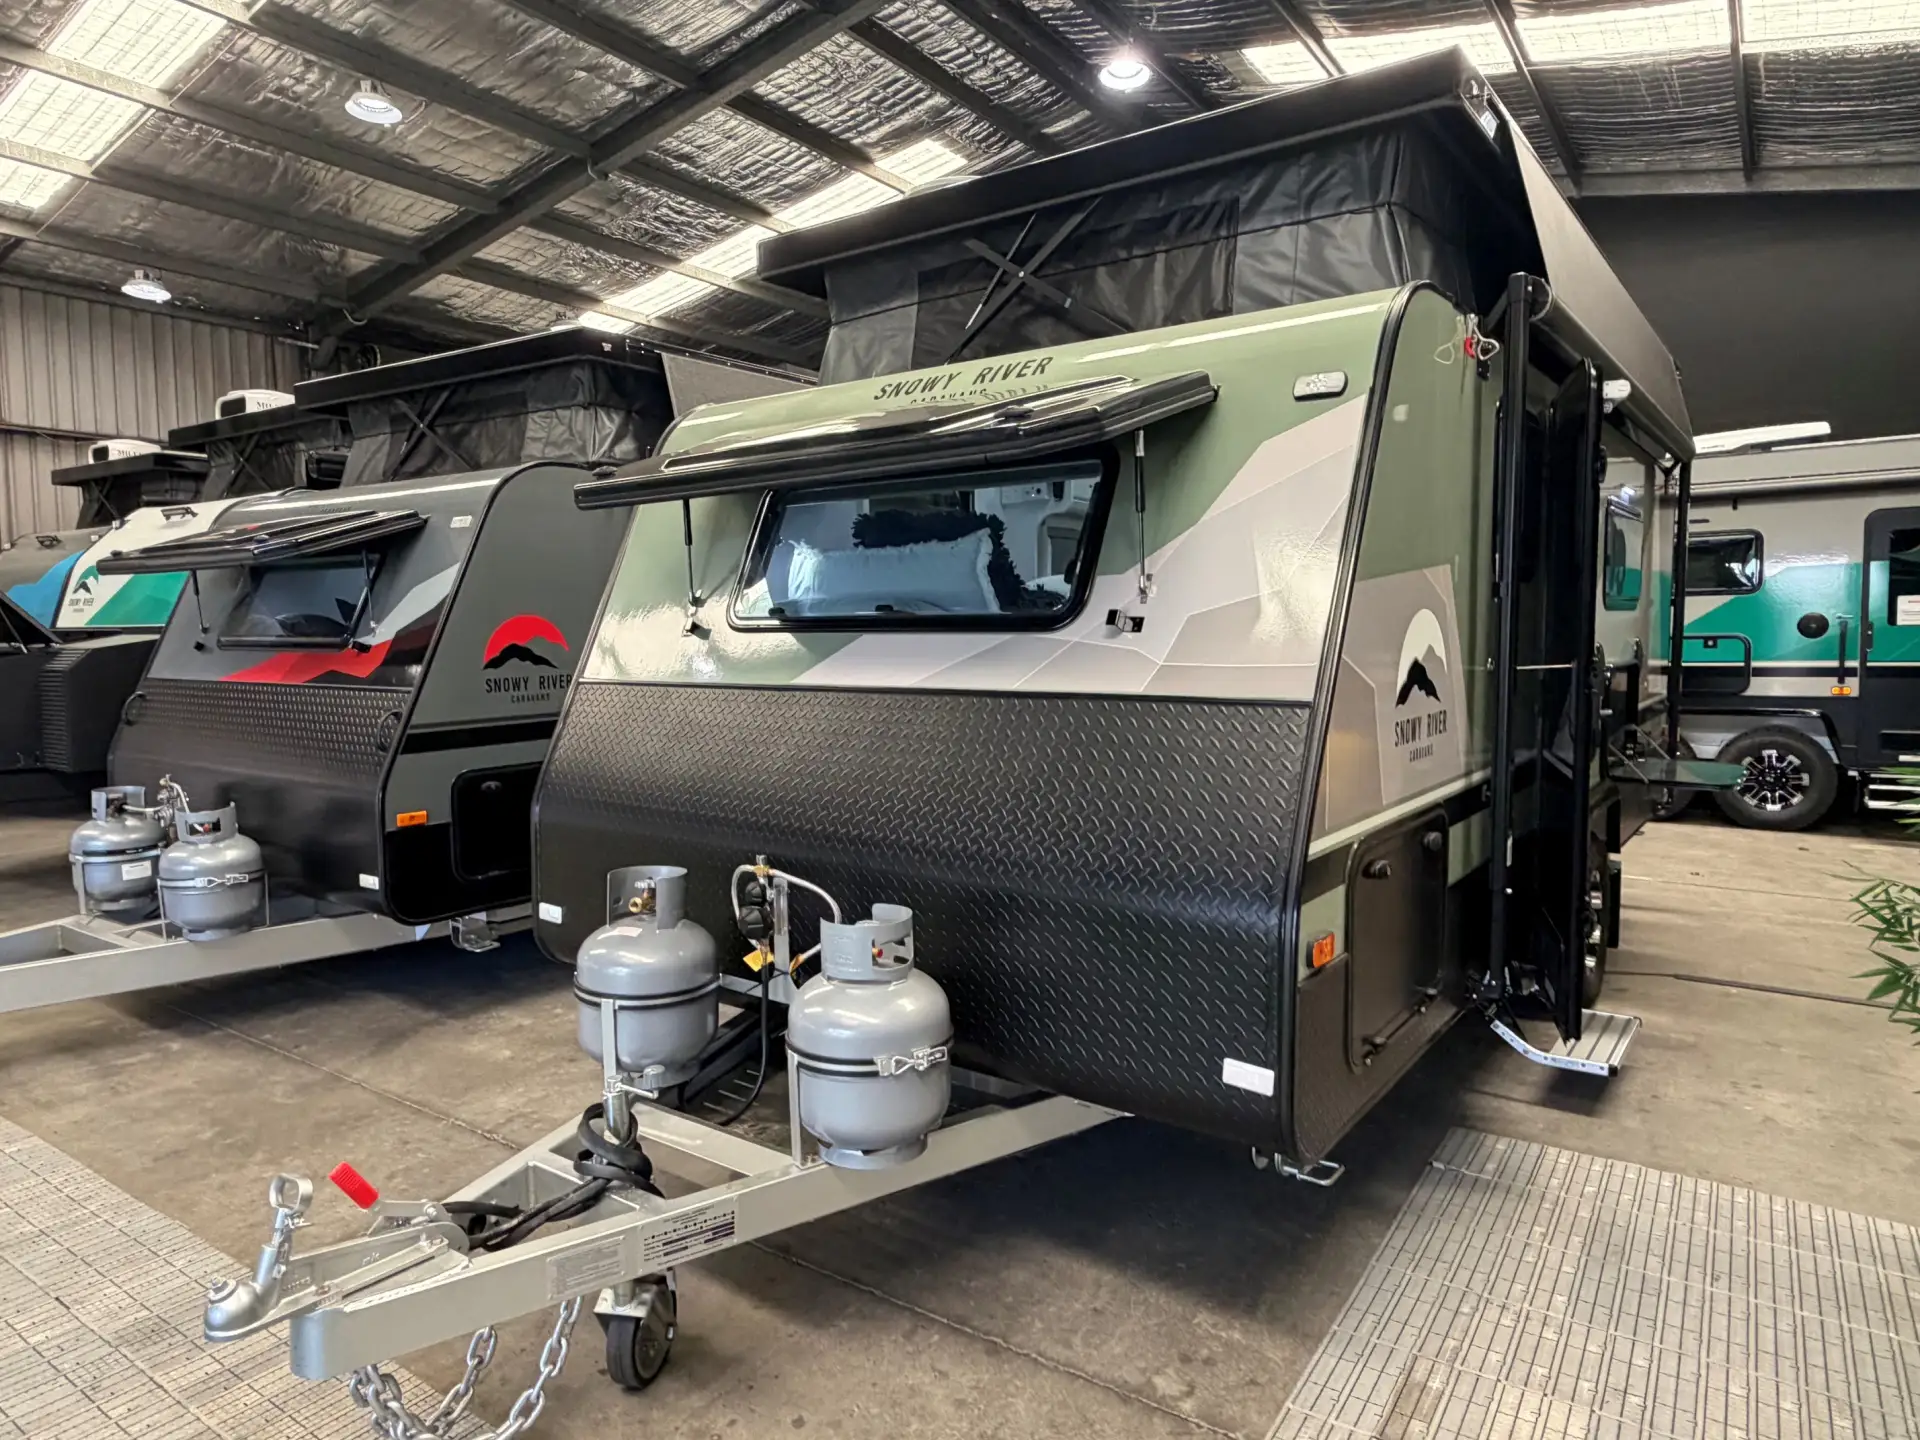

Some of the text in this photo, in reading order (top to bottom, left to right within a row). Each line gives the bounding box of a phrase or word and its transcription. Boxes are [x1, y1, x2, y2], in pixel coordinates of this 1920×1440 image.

[873, 356, 1054, 401] SNOWY RIVER
[485, 674, 573, 694] SNOWY RIVER
[511, 693, 550, 703] CARAVANS
[1394, 709, 1447, 748] SNOWY RIVER
